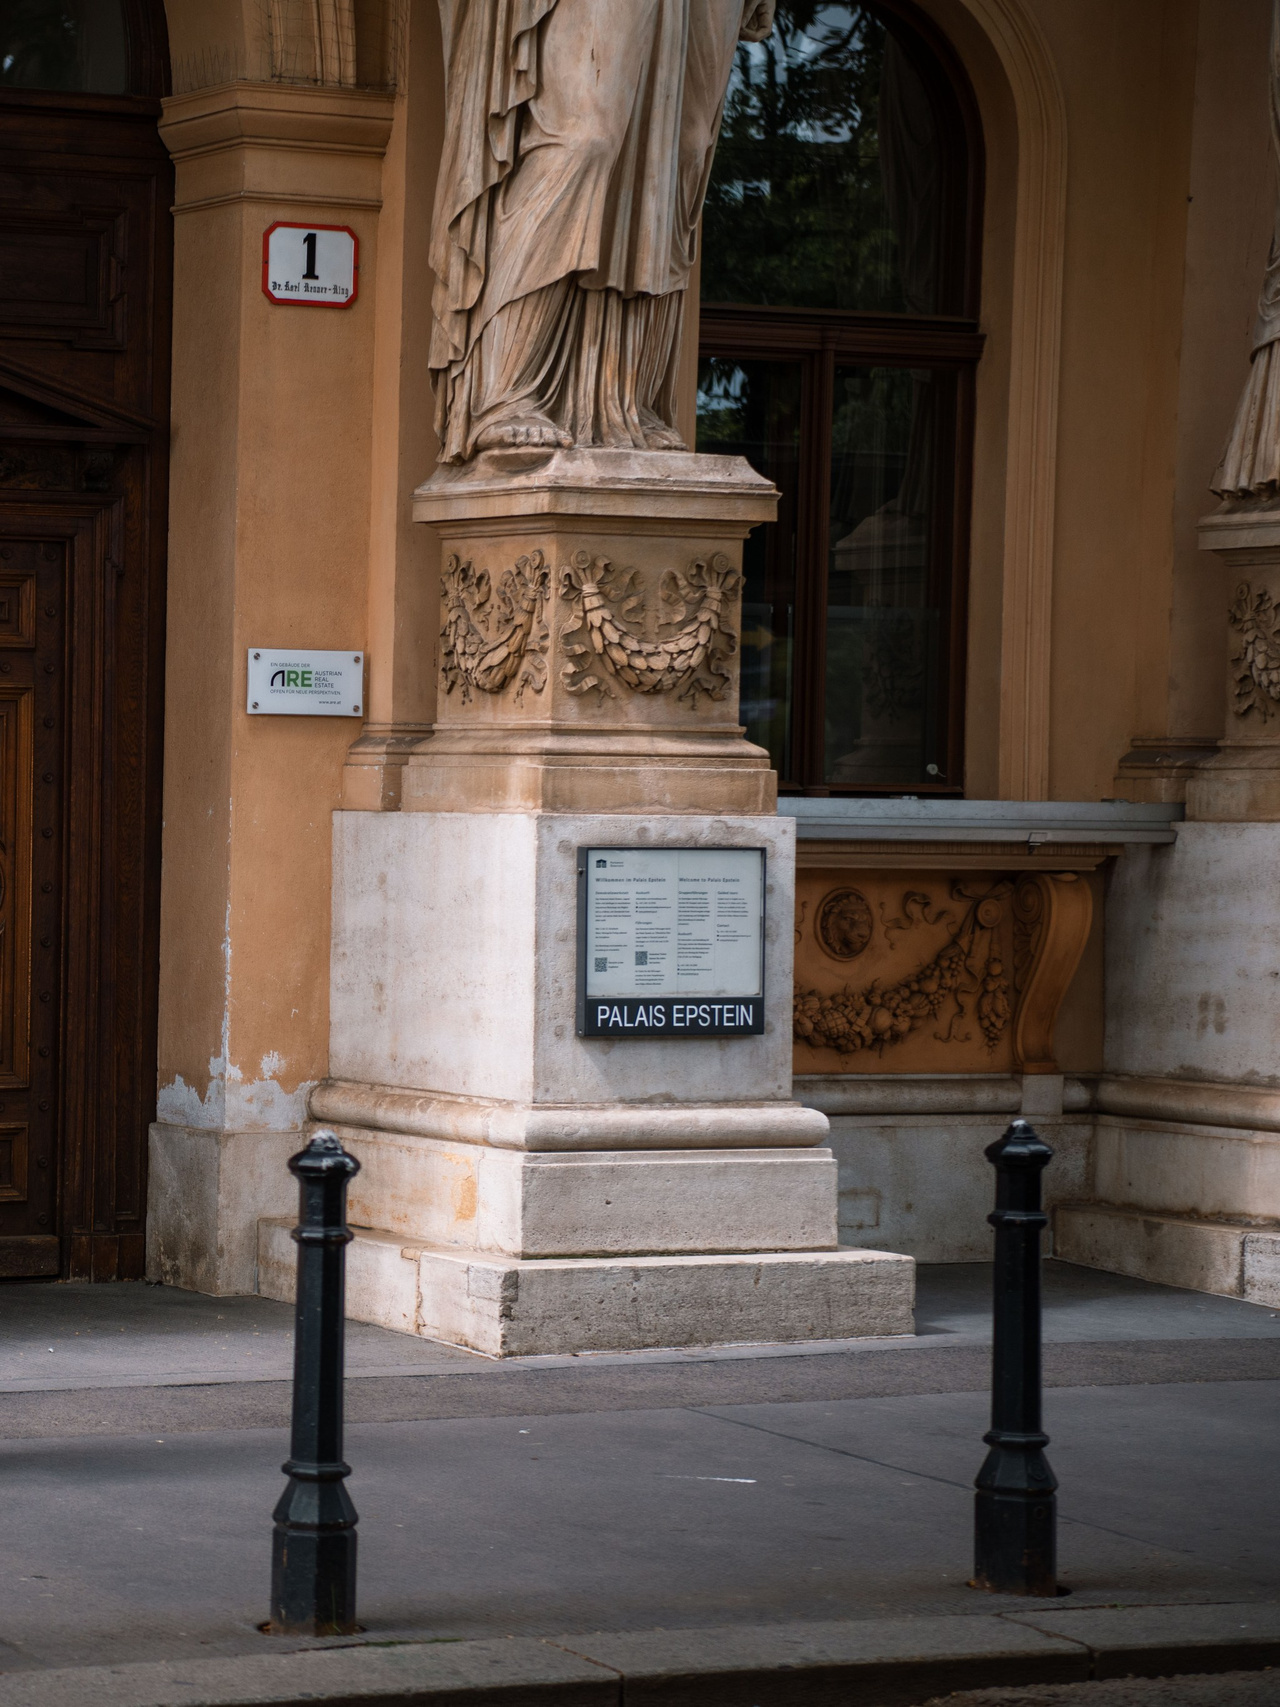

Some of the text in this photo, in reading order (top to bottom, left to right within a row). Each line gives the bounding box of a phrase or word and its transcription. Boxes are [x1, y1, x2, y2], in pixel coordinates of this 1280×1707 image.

[302, 232, 319, 280] 1
[271, 281, 283, 291] Dr.
[284, 281, 300, 292] Karl
[270, 670, 313, 688] ARE
[597, 1004, 753, 1028] PALAIS EPSTEIN
